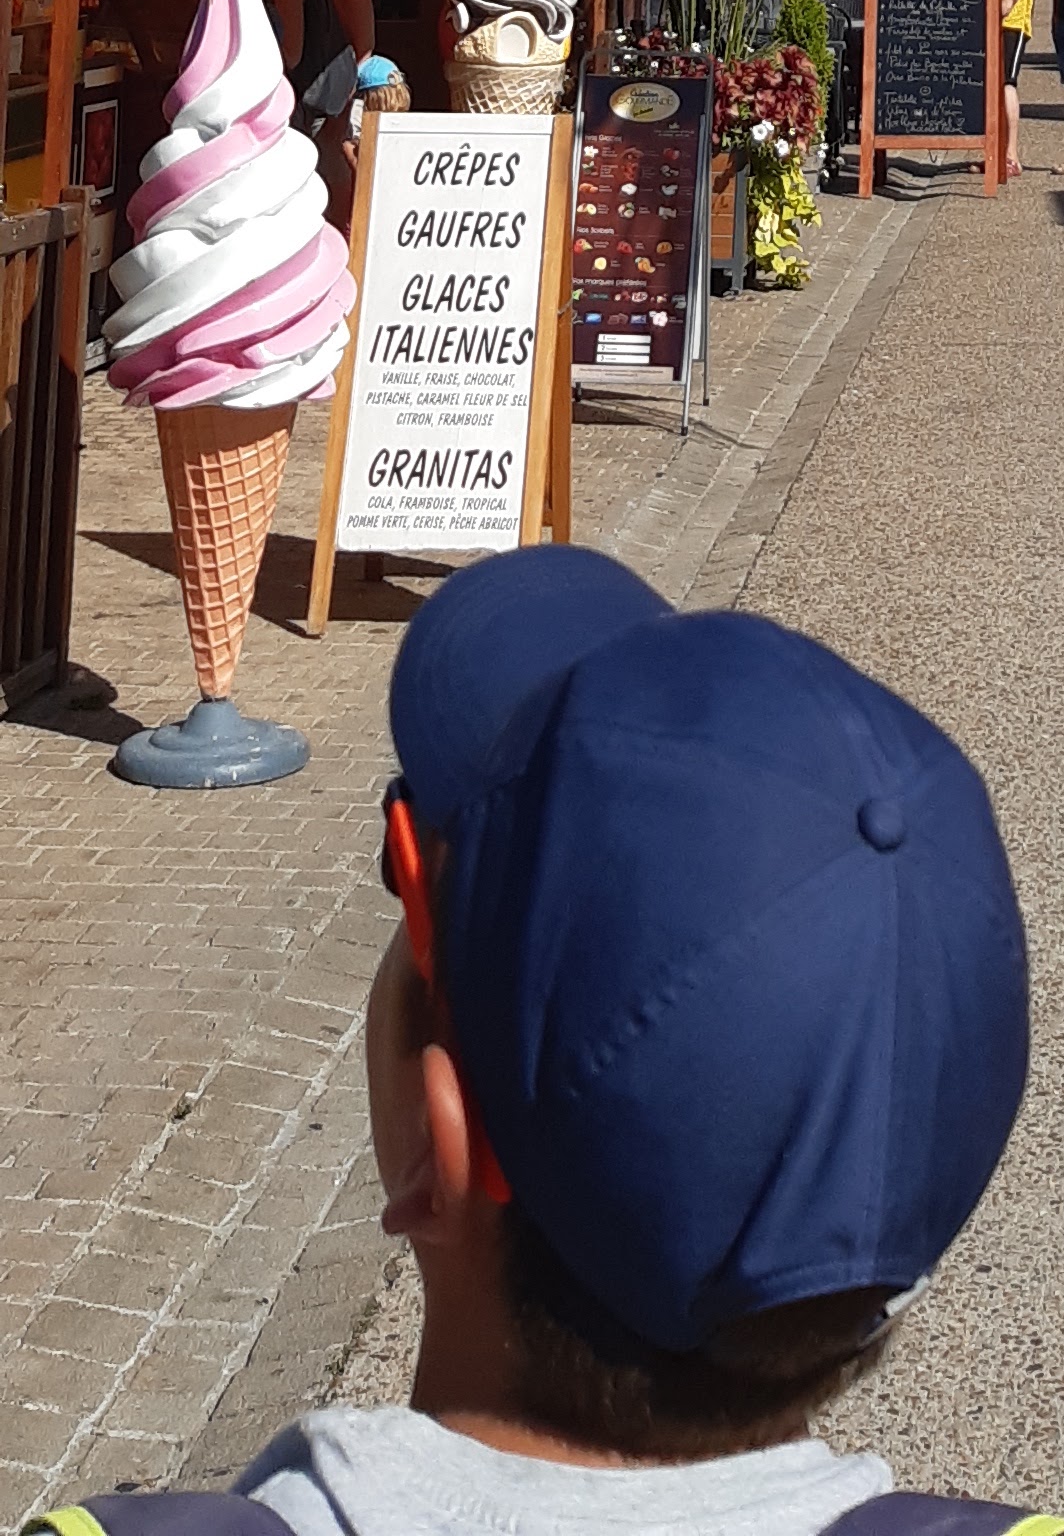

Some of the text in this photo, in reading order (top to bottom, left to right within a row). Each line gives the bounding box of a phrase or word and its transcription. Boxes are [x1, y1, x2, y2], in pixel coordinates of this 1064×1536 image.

[413, 142, 520, 186] CRÊPES
[398, 210, 526, 249] GAUFRES
[402, 274, 510, 313] GLACES
[369, 324, 534, 365] ITALIENNES
[382, 371, 515, 388] VANILLE, FRAISE, CHOCOLAT,
[366, 392, 527, 407] PISTACHE, CARAMEL FLEUR DE SEL
[396, 413, 494, 427] CITRON, FRAMBOISE
[368, 448, 513, 490] GRANITAS
[367, 496, 508, 512] COLA, FRAMBOISE, TROPICAL
[346, 513, 518, 531] POMME VERTE, CERISE, PÊCHE ABRICOT
